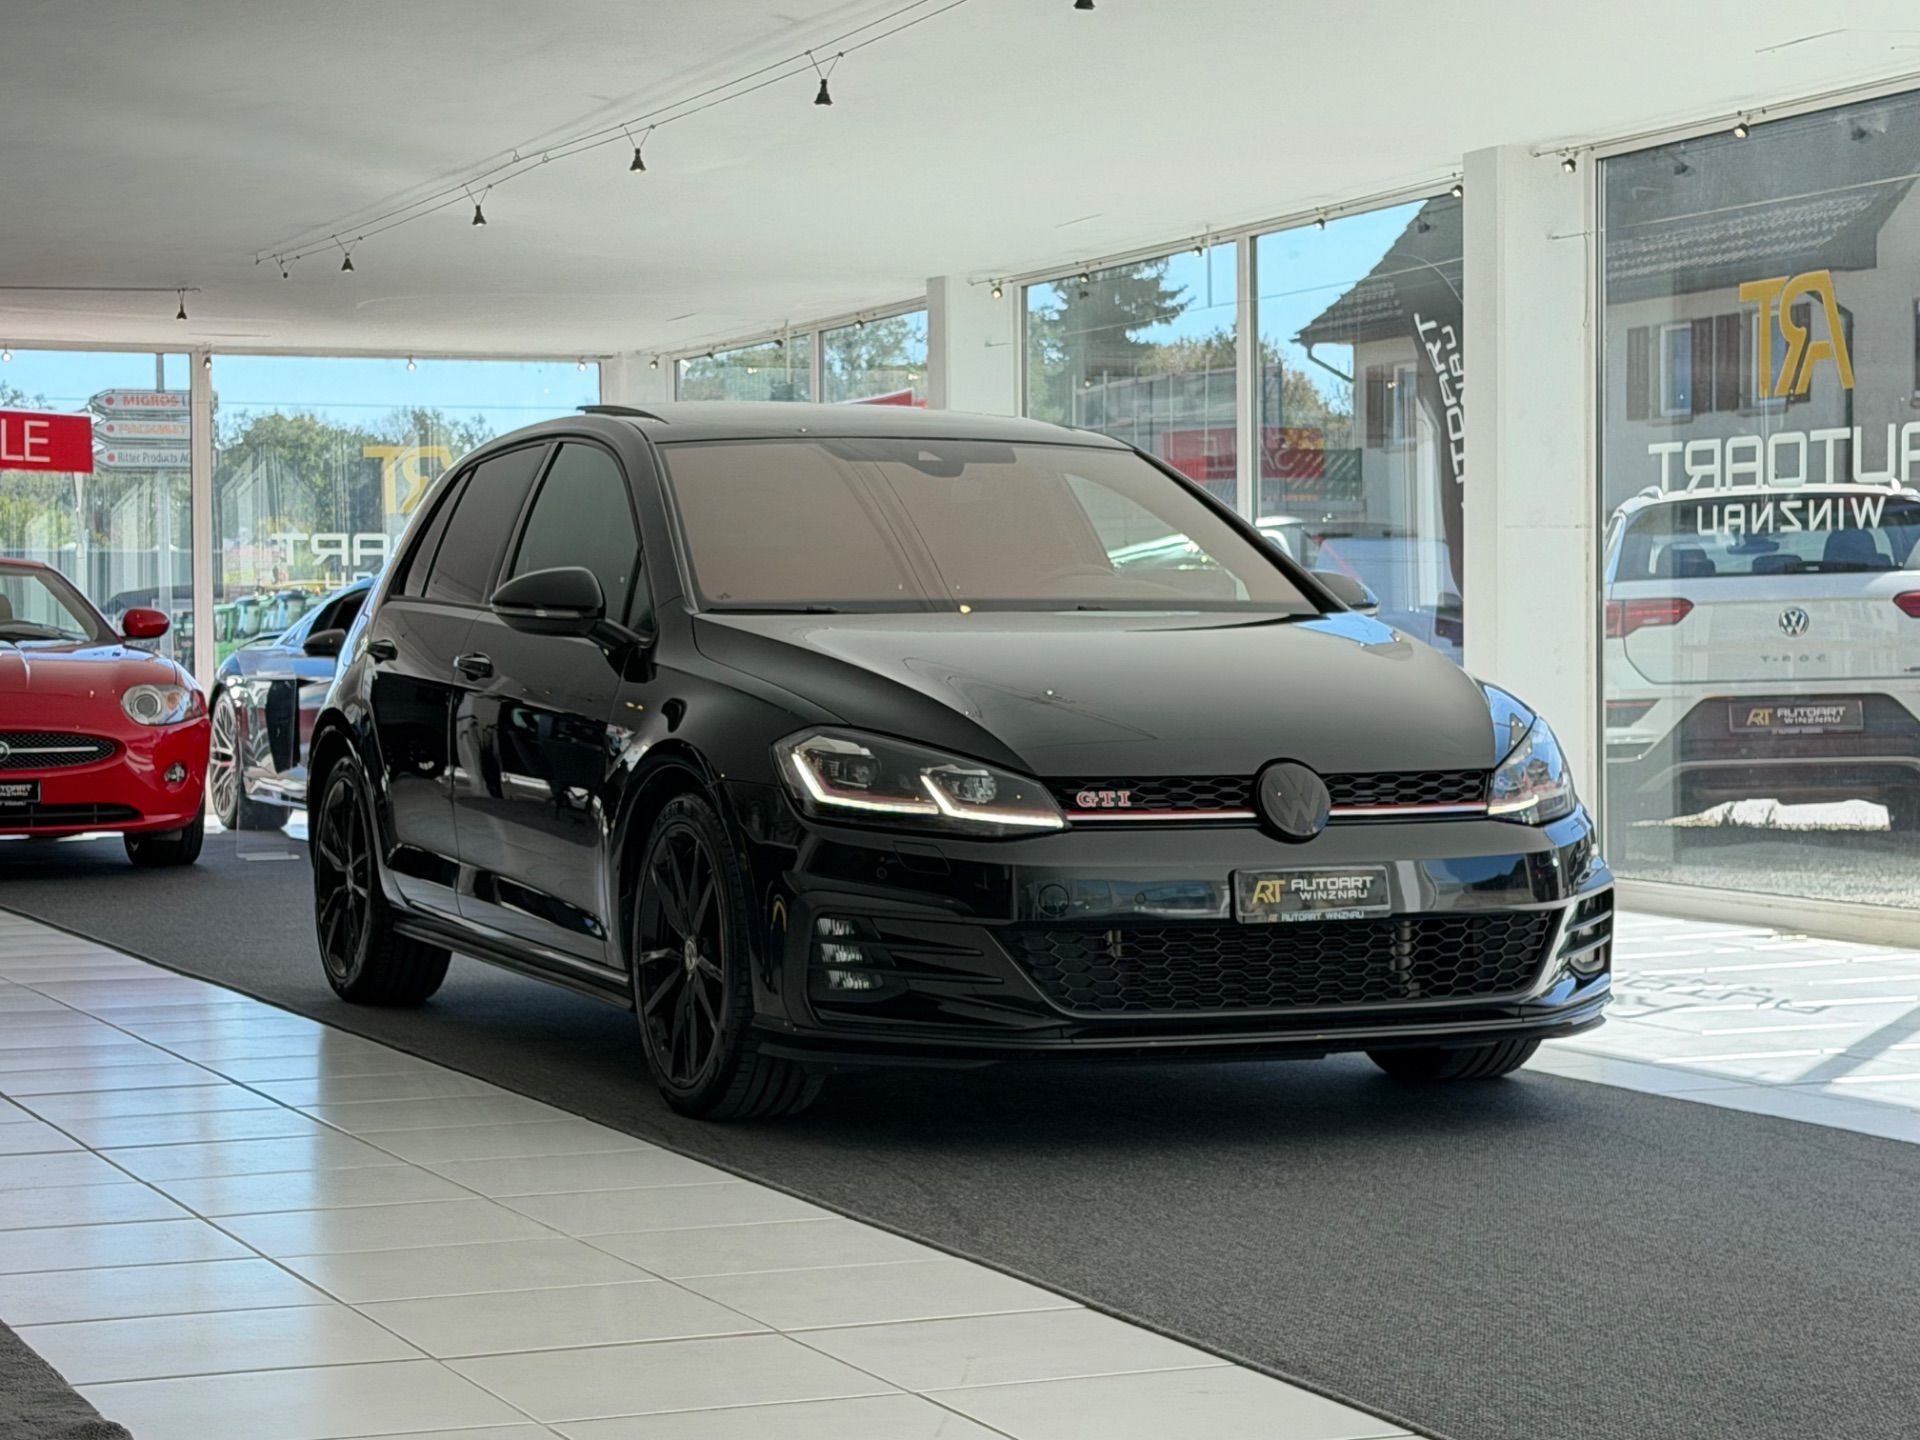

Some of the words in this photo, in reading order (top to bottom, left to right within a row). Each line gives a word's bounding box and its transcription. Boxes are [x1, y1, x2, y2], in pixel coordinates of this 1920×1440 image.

[122, 395, 178, 406] MIGROS
[1777, 706, 1846, 718] AUTOART
[1076, 790, 1132, 808] GTI
[1291, 876, 1374, 891] AUTOART
[1299, 889, 1368, 901] WINZNAU
[1281, 911, 1322, 922] AUTOART
